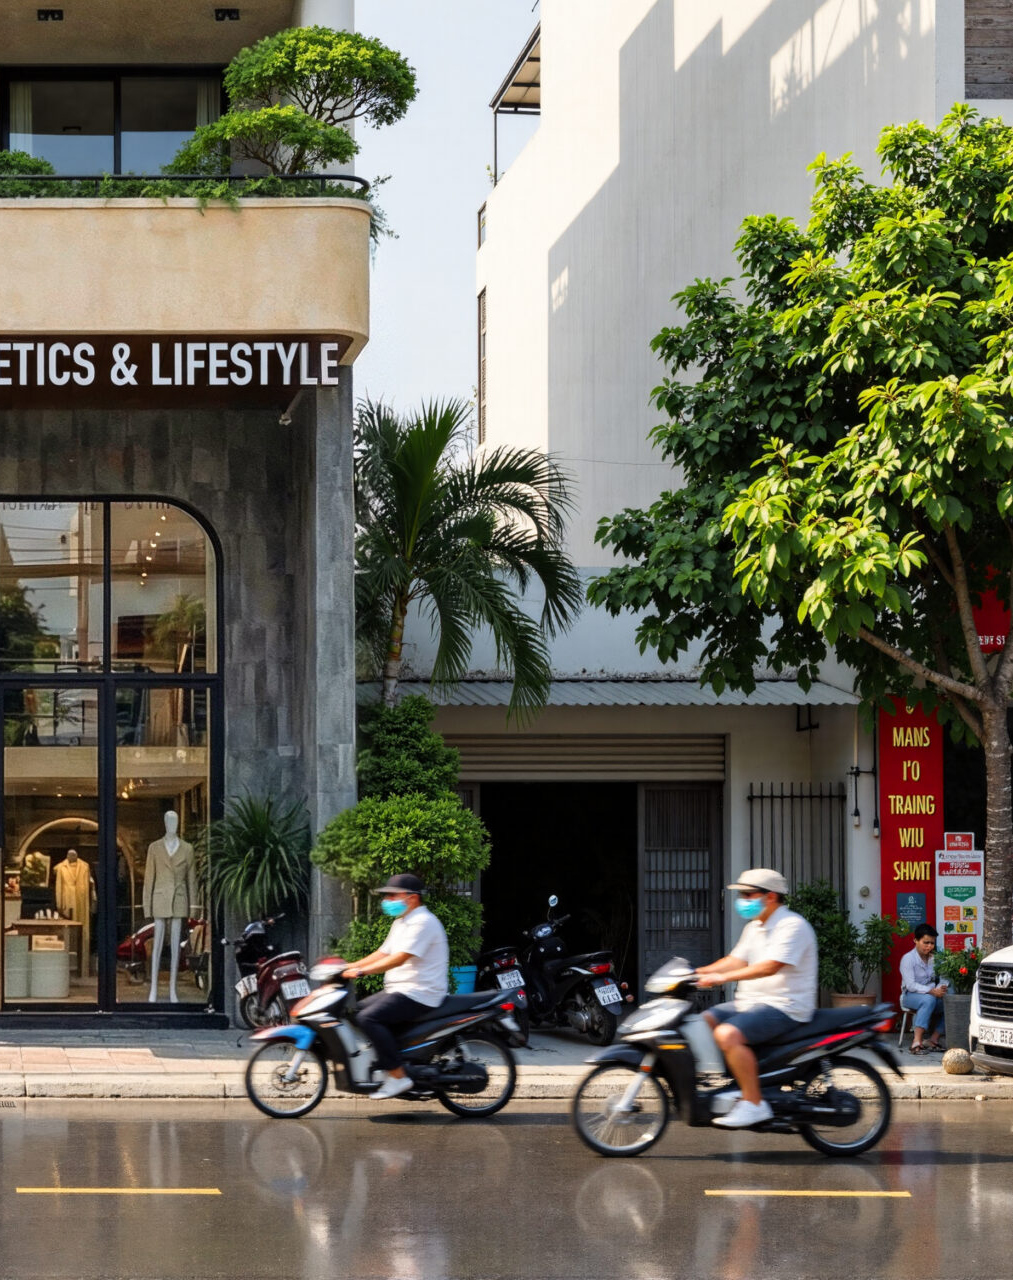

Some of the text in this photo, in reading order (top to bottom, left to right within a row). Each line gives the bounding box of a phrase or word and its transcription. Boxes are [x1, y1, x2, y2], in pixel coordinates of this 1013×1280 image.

[110, 342, 138, 386] &
[151, 342, 339, 386] LIFESTYLE
[892, 726, 931, 747] MANS
[888, 794, 936, 815] TRAING
